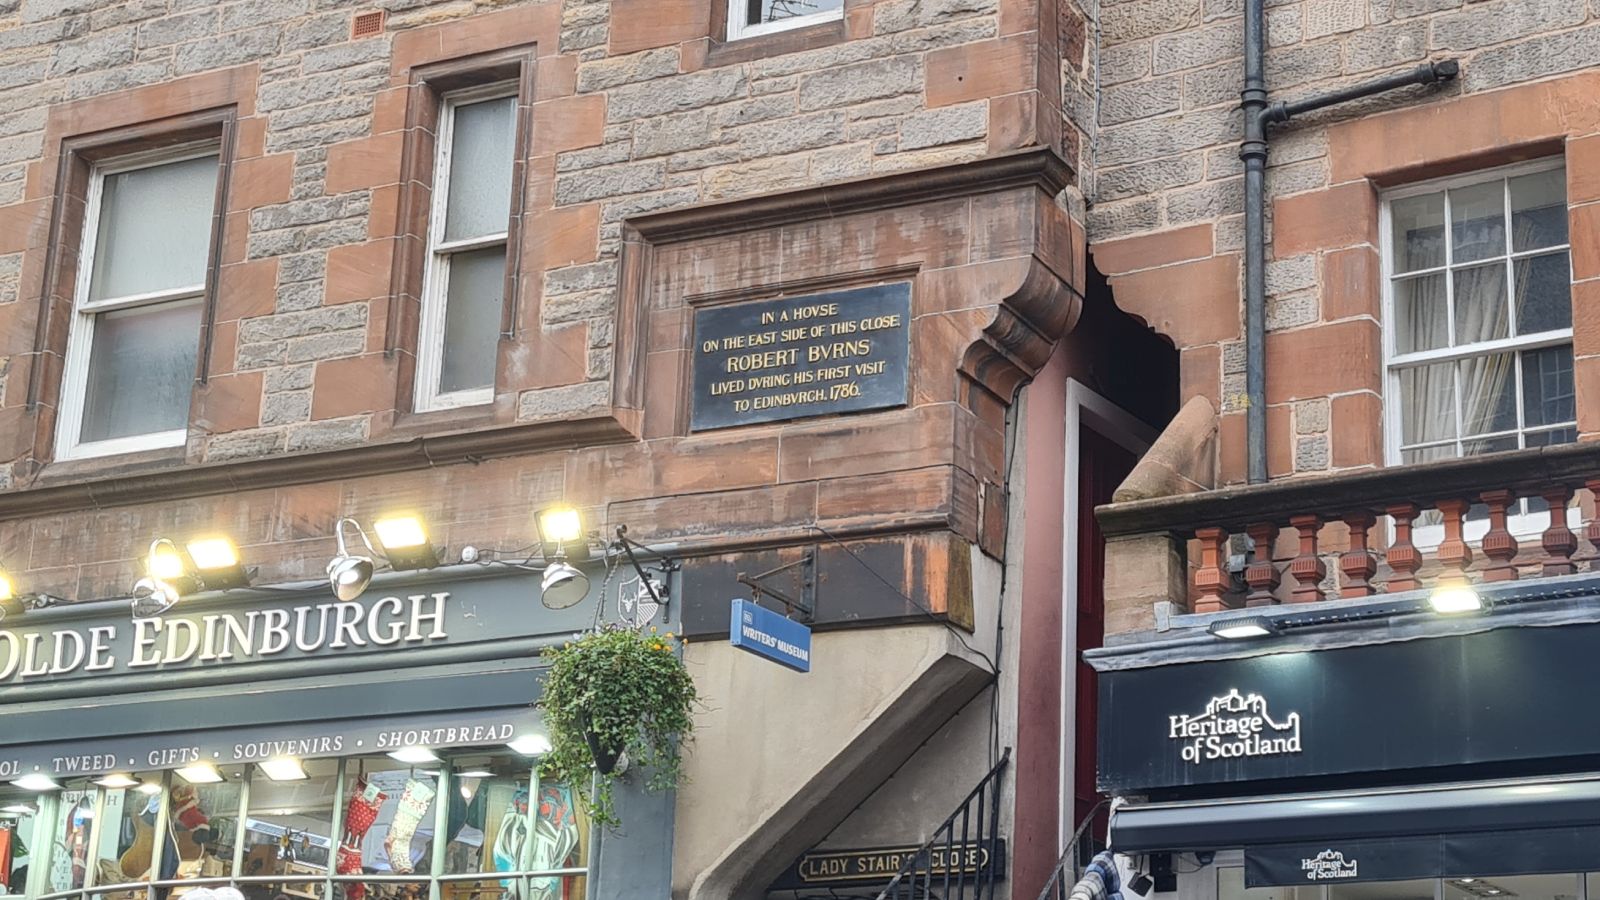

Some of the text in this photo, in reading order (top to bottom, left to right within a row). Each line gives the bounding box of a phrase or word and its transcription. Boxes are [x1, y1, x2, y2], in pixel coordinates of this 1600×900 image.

[761, 303, 838, 325] IN A HOVSE
[703, 340, 719, 353] ON
[723, 335, 745, 349] THE
[749, 331, 777, 346] EAST
[780, 328, 807, 342] SIDE
[811, 326, 826, 338] OF
[830, 320, 856, 335] THIS
[727, 339, 871, 373] ROBERT BVRNS
[711, 380, 745, 396] LIVED
[794, 371, 814, 384] HIS
[817, 365, 851, 381] FIRST
[854, 361, 886, 375] VISIT
[734, 400, 750, 412] TO
[830, 382, 861, 400] 1786.
[128, 592, 450, 667] EDINBURGH
[777, 640, 808, 661] MUSEUM
[1169, 714, 1263, 738] Heritage
[53, 754, 116, 772] TWEED
[148, 747, 200, 766] GIFTS
[233, 735, 343, 760] SOUVENIRS
[376, 724, 515, 748] SHORTBREAD
[1182, 729, 1302, 764] of Scotland
[809, 858, 849, 876] LADY
[1301, 858, 1341, 870] Heritage
[1307, 866, 1357, 880] of Scotland
